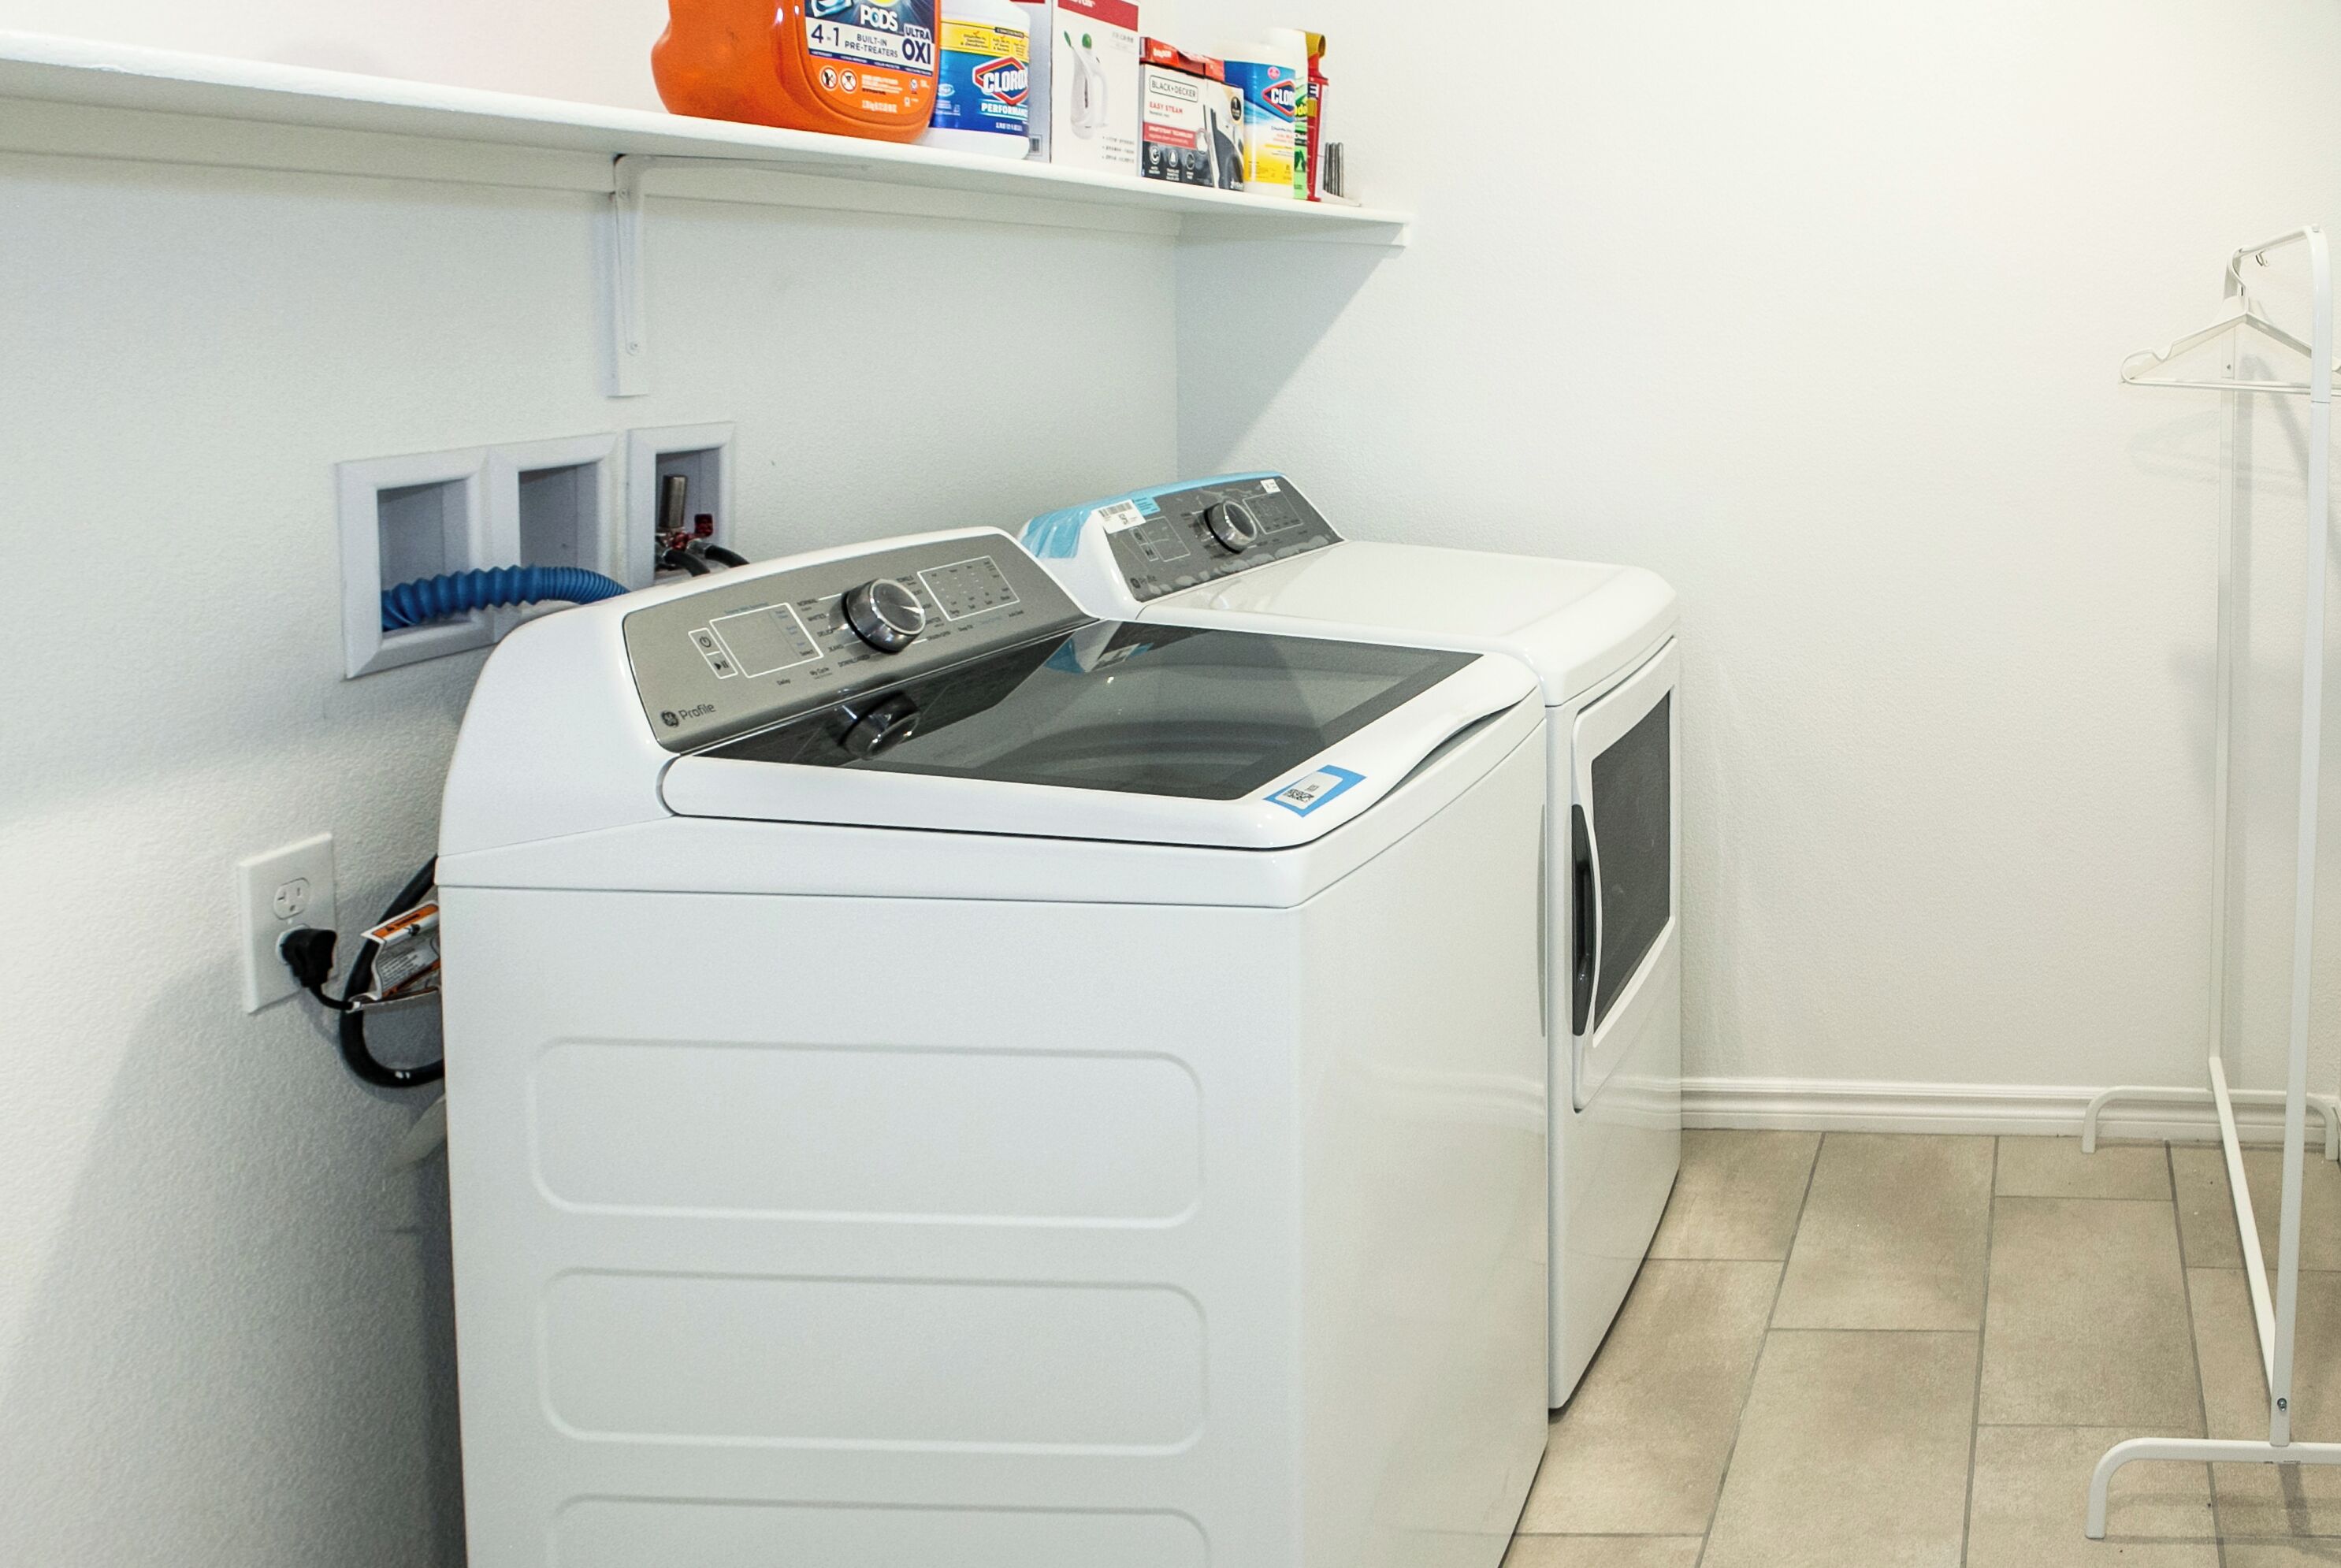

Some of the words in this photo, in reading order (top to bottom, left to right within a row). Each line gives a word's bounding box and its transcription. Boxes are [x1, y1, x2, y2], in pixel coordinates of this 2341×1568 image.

[860, 5, 898, 32] PODS
[811, 24, 824, 44] 4
[833, 27, 839, 46] 1
[857, 33, 887, 46] BUILT-IN
[905, 25, 931, 40] ULTRA
[845, 40, 898, 58] PRE-TREATERS
[902, 38, 931, 65] OXI
[1150, 102, 1165, 110] EASY
[1166, 105, 1184, 114] STEAM
[678, 704, 716, 719] Profile
